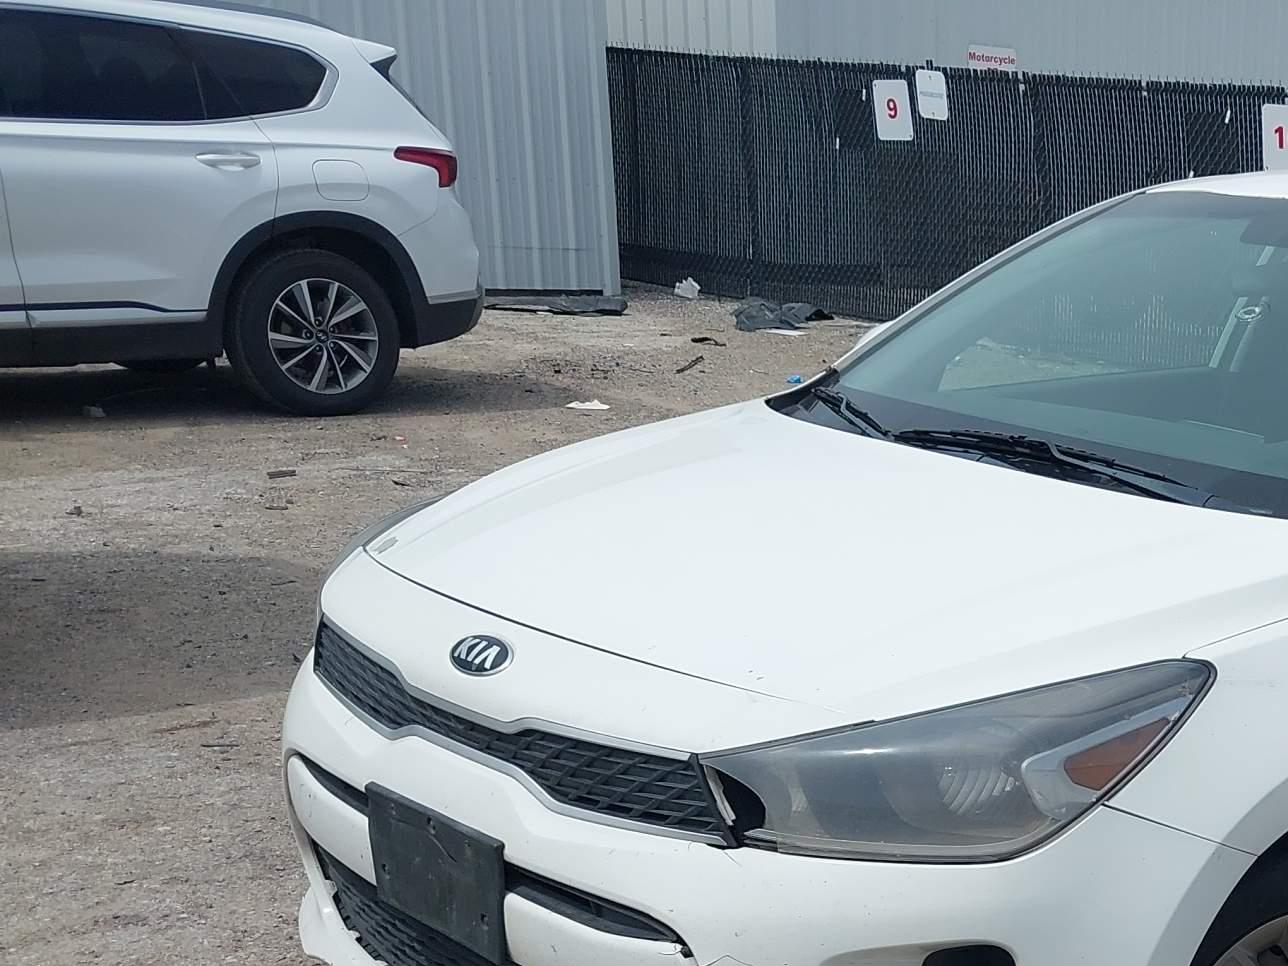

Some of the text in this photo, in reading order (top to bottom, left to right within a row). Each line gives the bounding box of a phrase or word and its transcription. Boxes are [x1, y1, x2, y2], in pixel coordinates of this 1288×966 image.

[968, 51, 1016, 66] Motorcycle
[886, 98, 898, 119] 9
[453, 637, 501, 670] KIA
